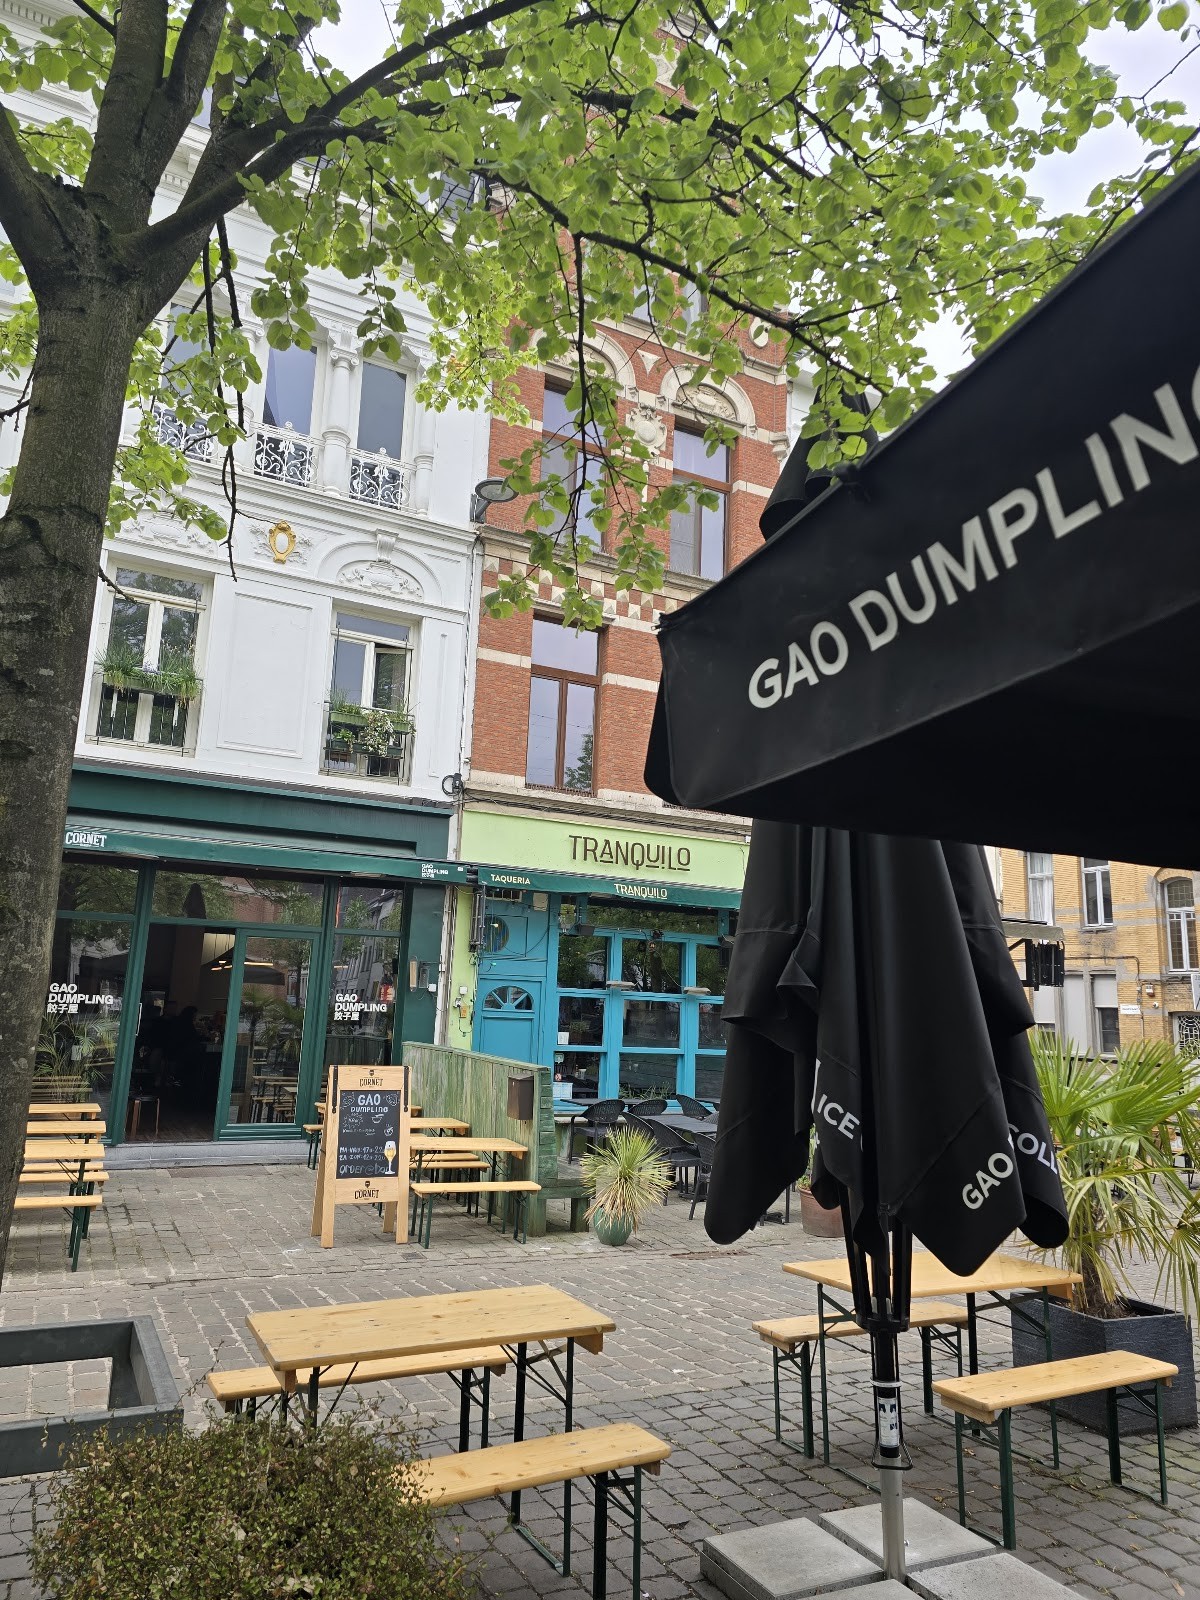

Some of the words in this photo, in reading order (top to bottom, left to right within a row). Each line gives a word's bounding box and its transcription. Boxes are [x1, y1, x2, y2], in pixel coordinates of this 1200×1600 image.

[748, 621, 849, 709] GAO
[848, 364, 1200, 652] DUMPLIN
[65, 831, 107, 847] CORNET
[569, 834, 691, 871] TRANQUILO
[490, 873, 531, 885] TAQUERIA
[614, 883, 668, 900] TRANQUILO
[50, 983, 77, 993] GAO
[48, 993, 113, 1004] DUMPLING
[335, 993, 358, 1002] GAO
[334, 1003, 387, 1012] DUMPLING
[359, 1078, 383, 1087] CORNET
[357, 1093, 381, 1106] GAO
[962, 1152, 1014, 1210] GAO
[355, 1190, 379, 1200] CORNET
